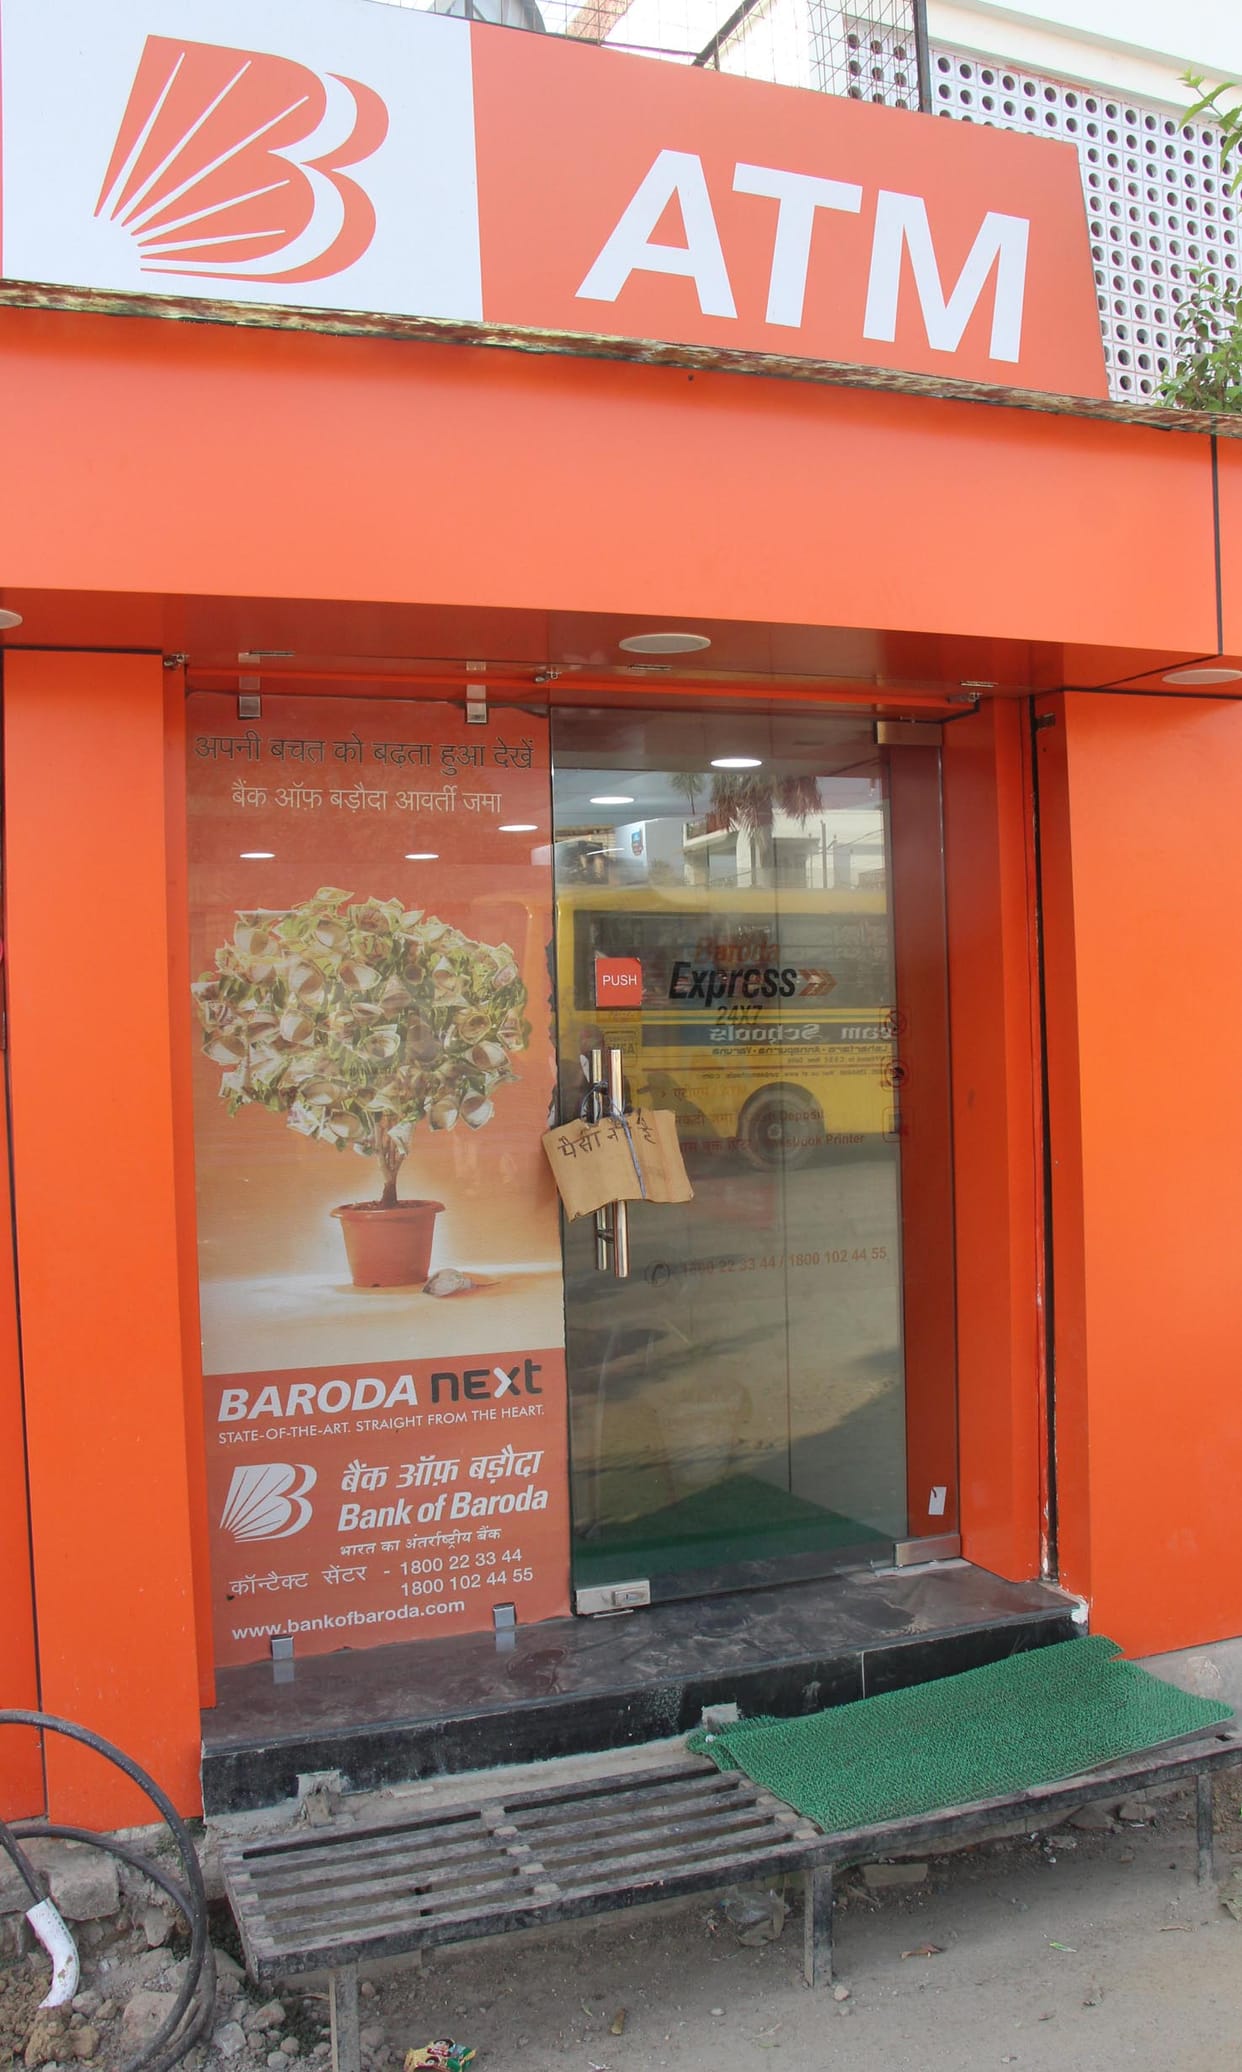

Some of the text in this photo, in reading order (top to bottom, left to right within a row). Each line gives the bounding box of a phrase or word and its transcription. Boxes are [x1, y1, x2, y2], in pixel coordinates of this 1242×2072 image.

[576, 148, 1031, 364] ATM
[195, 730, 534, 776] अपनी बचत को बढ़ता हुआ देखें
[232, 779, 268, 809] बैंक
[329, 782, 388, 814] बड़ौदा
[395, 785, 457, 813] आवर्ती
[462, 791, 503, 814] जमा
[602, 975, 638, 987] PUSH
[668, 961, 798, 1007] Express
[826, 1134, 865, 1145] Printer
[825, 1250, 848, 1263] 102
[852, 1248, 867, 1261] 44
[871, 1246, 887, 1259] 55
[217, 1374, 419, 1422] BARODA
[218, 1404, 545, 1444] STATE-OF-THE-ART. STRAIGHT FROM THE HEART.
[341, 1459, 390, 1493] बैंक
[468, 1444, 545, 1484] बड़ौदा
[337, 1484, 549, 1532] Bank of Baroda
[340, 1542, 376, 1556] भारत
[381, 1539, 401, 1552] का
[476, 1525, 502, 1541] बैंक
[229, 1570, 309, 1596] कॉन्टैक्ट
[321, 1564, 368, 1585] सेंटर
[400, 1557, 443, 1576] 1800
[448, 1554, 470, 1570] 22
[475, 1551, 496, 1567] 33
[501, 1548, 522, 1563] 44
[401, 1567, 533, 1597] 1800 102 44 55
[231, 1600, 465, 1640] www.bankofbaroda.com
